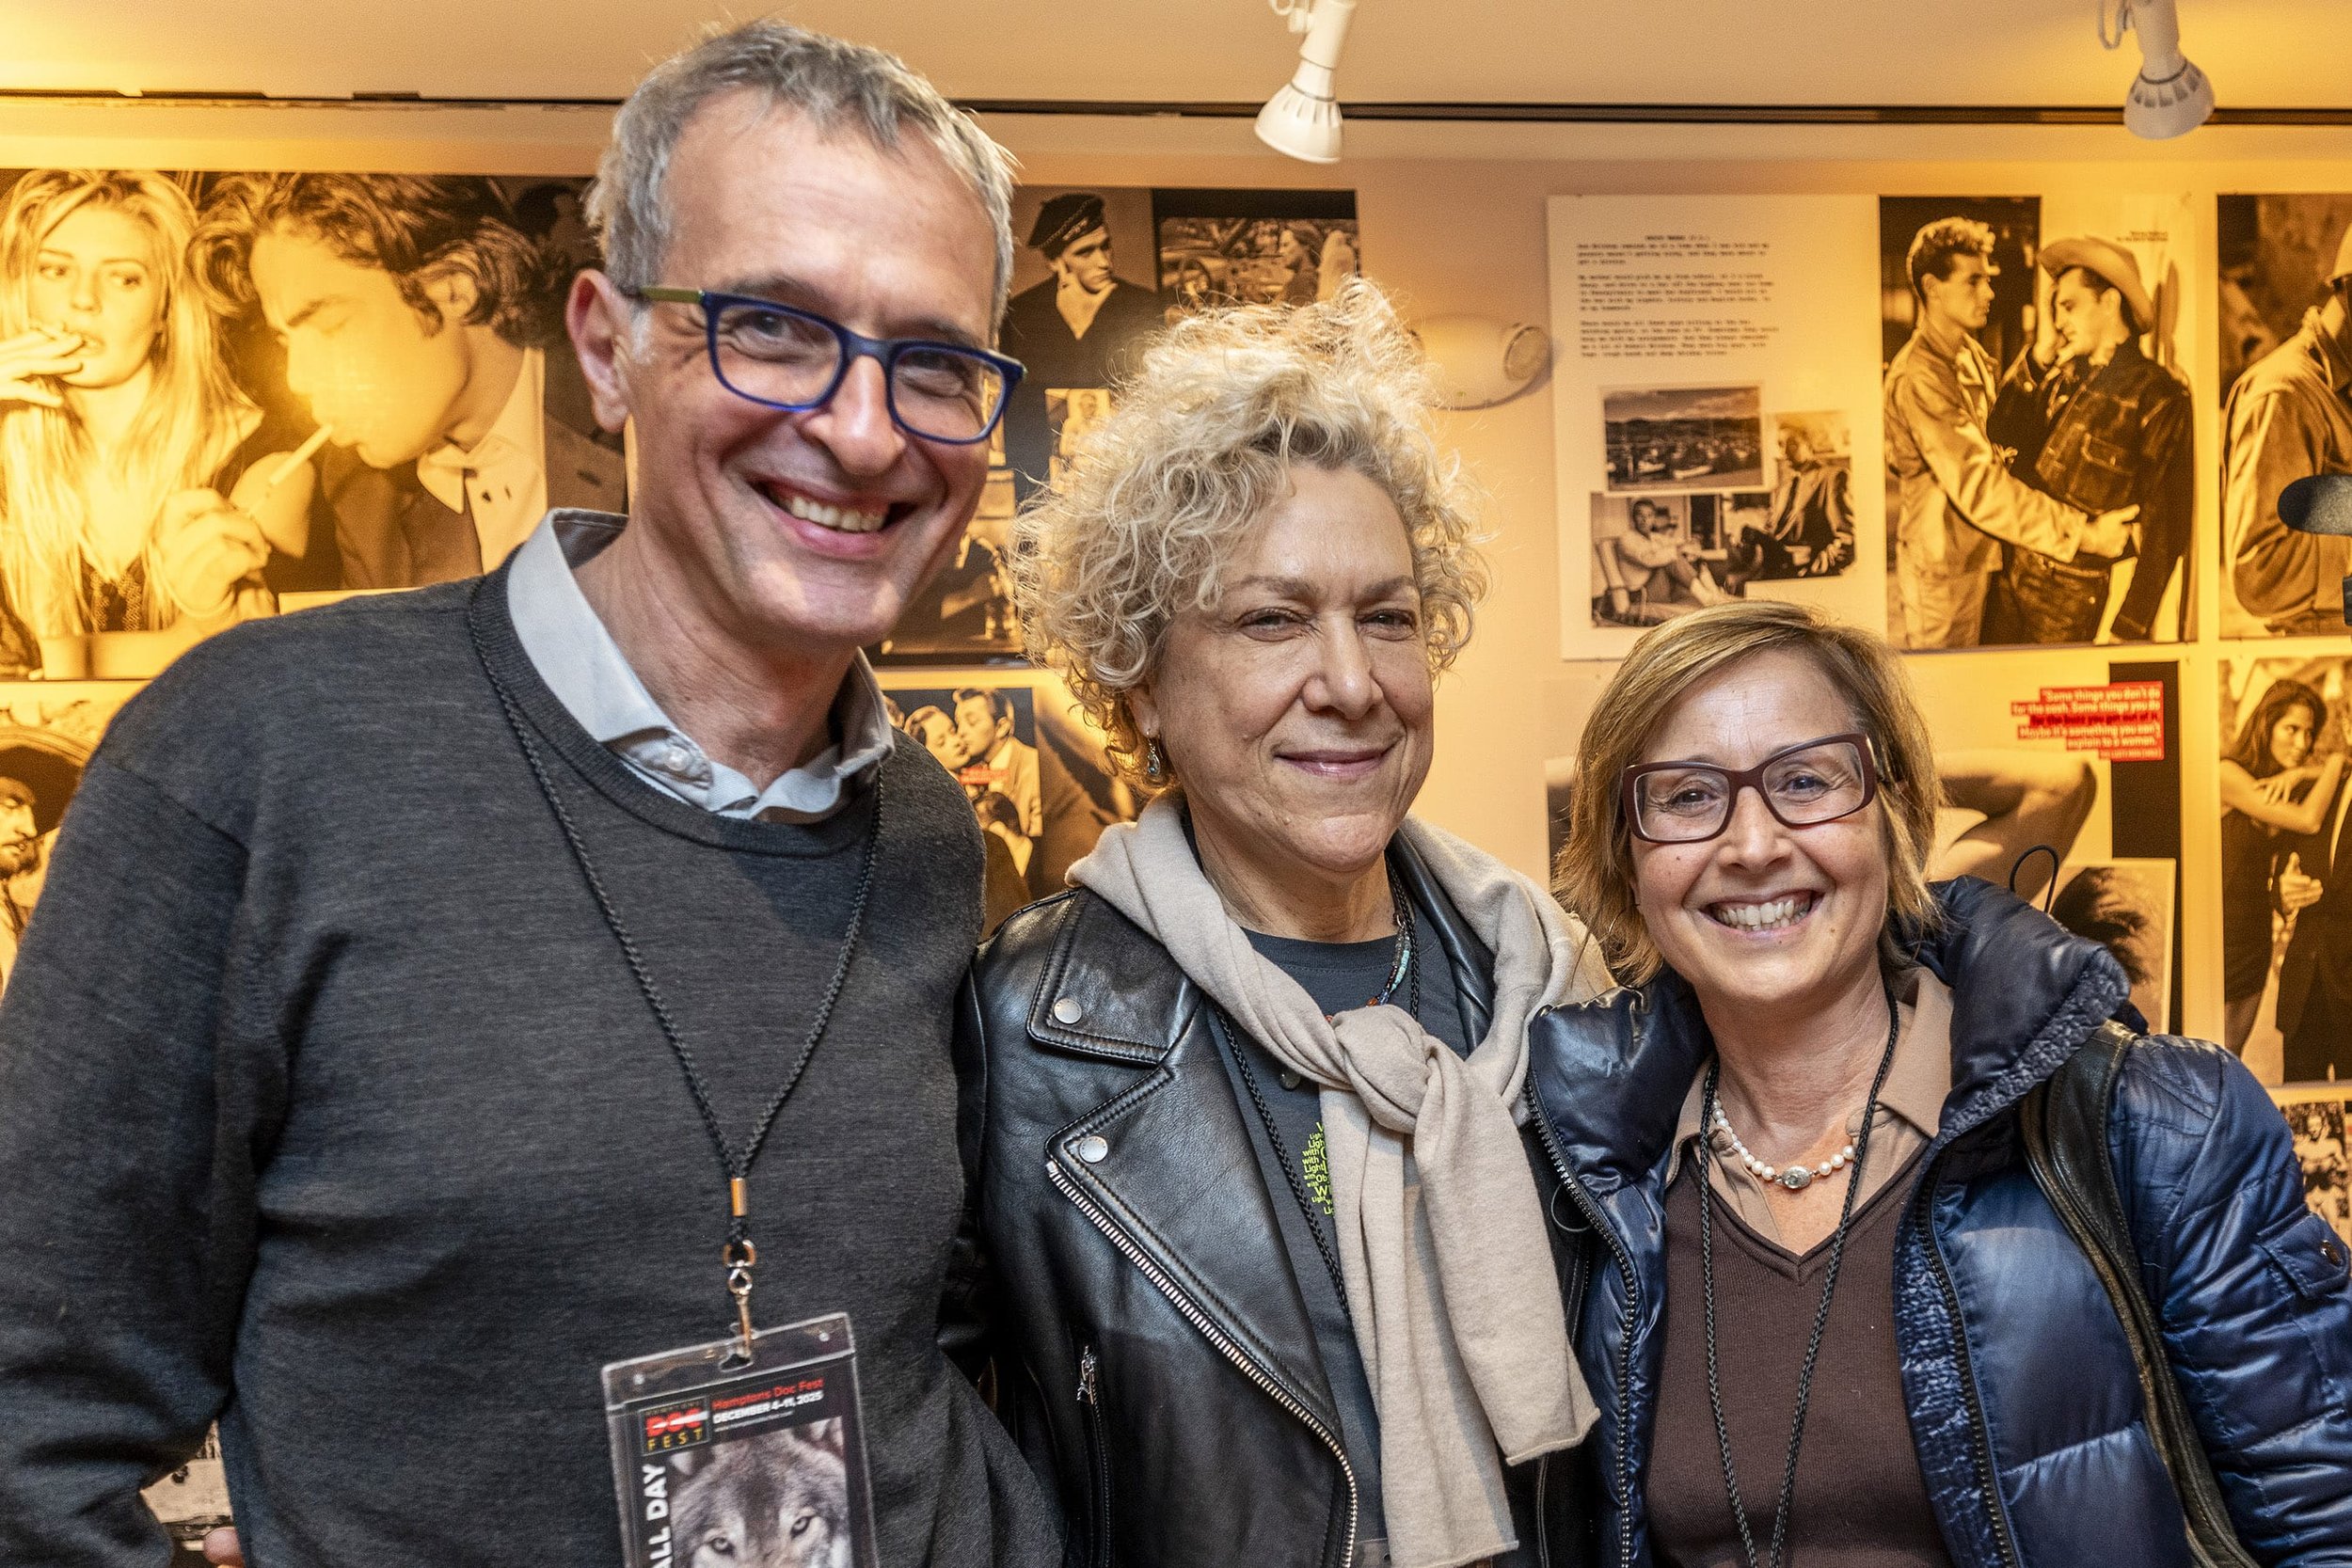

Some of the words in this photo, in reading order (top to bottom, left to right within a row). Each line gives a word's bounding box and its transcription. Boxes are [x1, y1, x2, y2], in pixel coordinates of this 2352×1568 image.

[2074, 689, 2105, 704] things
[2106, 689, 2122, 703] you
[2123, 686, 2146, 701] don't
[2148, 687, 2161, 700] do
[2028, 703, 2044, 715] the
[2071, 702, 2098, 714] Some
[2099, 700, 2129, 715] things
[2130, 700, 2148, 714] you
[2148, 699, 2161, 711] do
[2088, 715, 2105, 726] you
[2068, 723, 2119, 739] something
[2120, 722, 2137, 737] you
[2066, 736, 2101, 752] explain
[2101, 736, 2113, 748] to
[1301, 1148, 1320, 1157] with
[1301, 1156, 1320, 1165] with
[711, 1390, 772, 1411] Hamptons
[773, 1386, 797, 1399] Doc
[797, 1378, 825, 1392] Fest
[712, 1402, 772, 1425] DECEMBER
[796, 1389, 825, 1406] 2025
[642, 1463, 670, 1522] DAY
